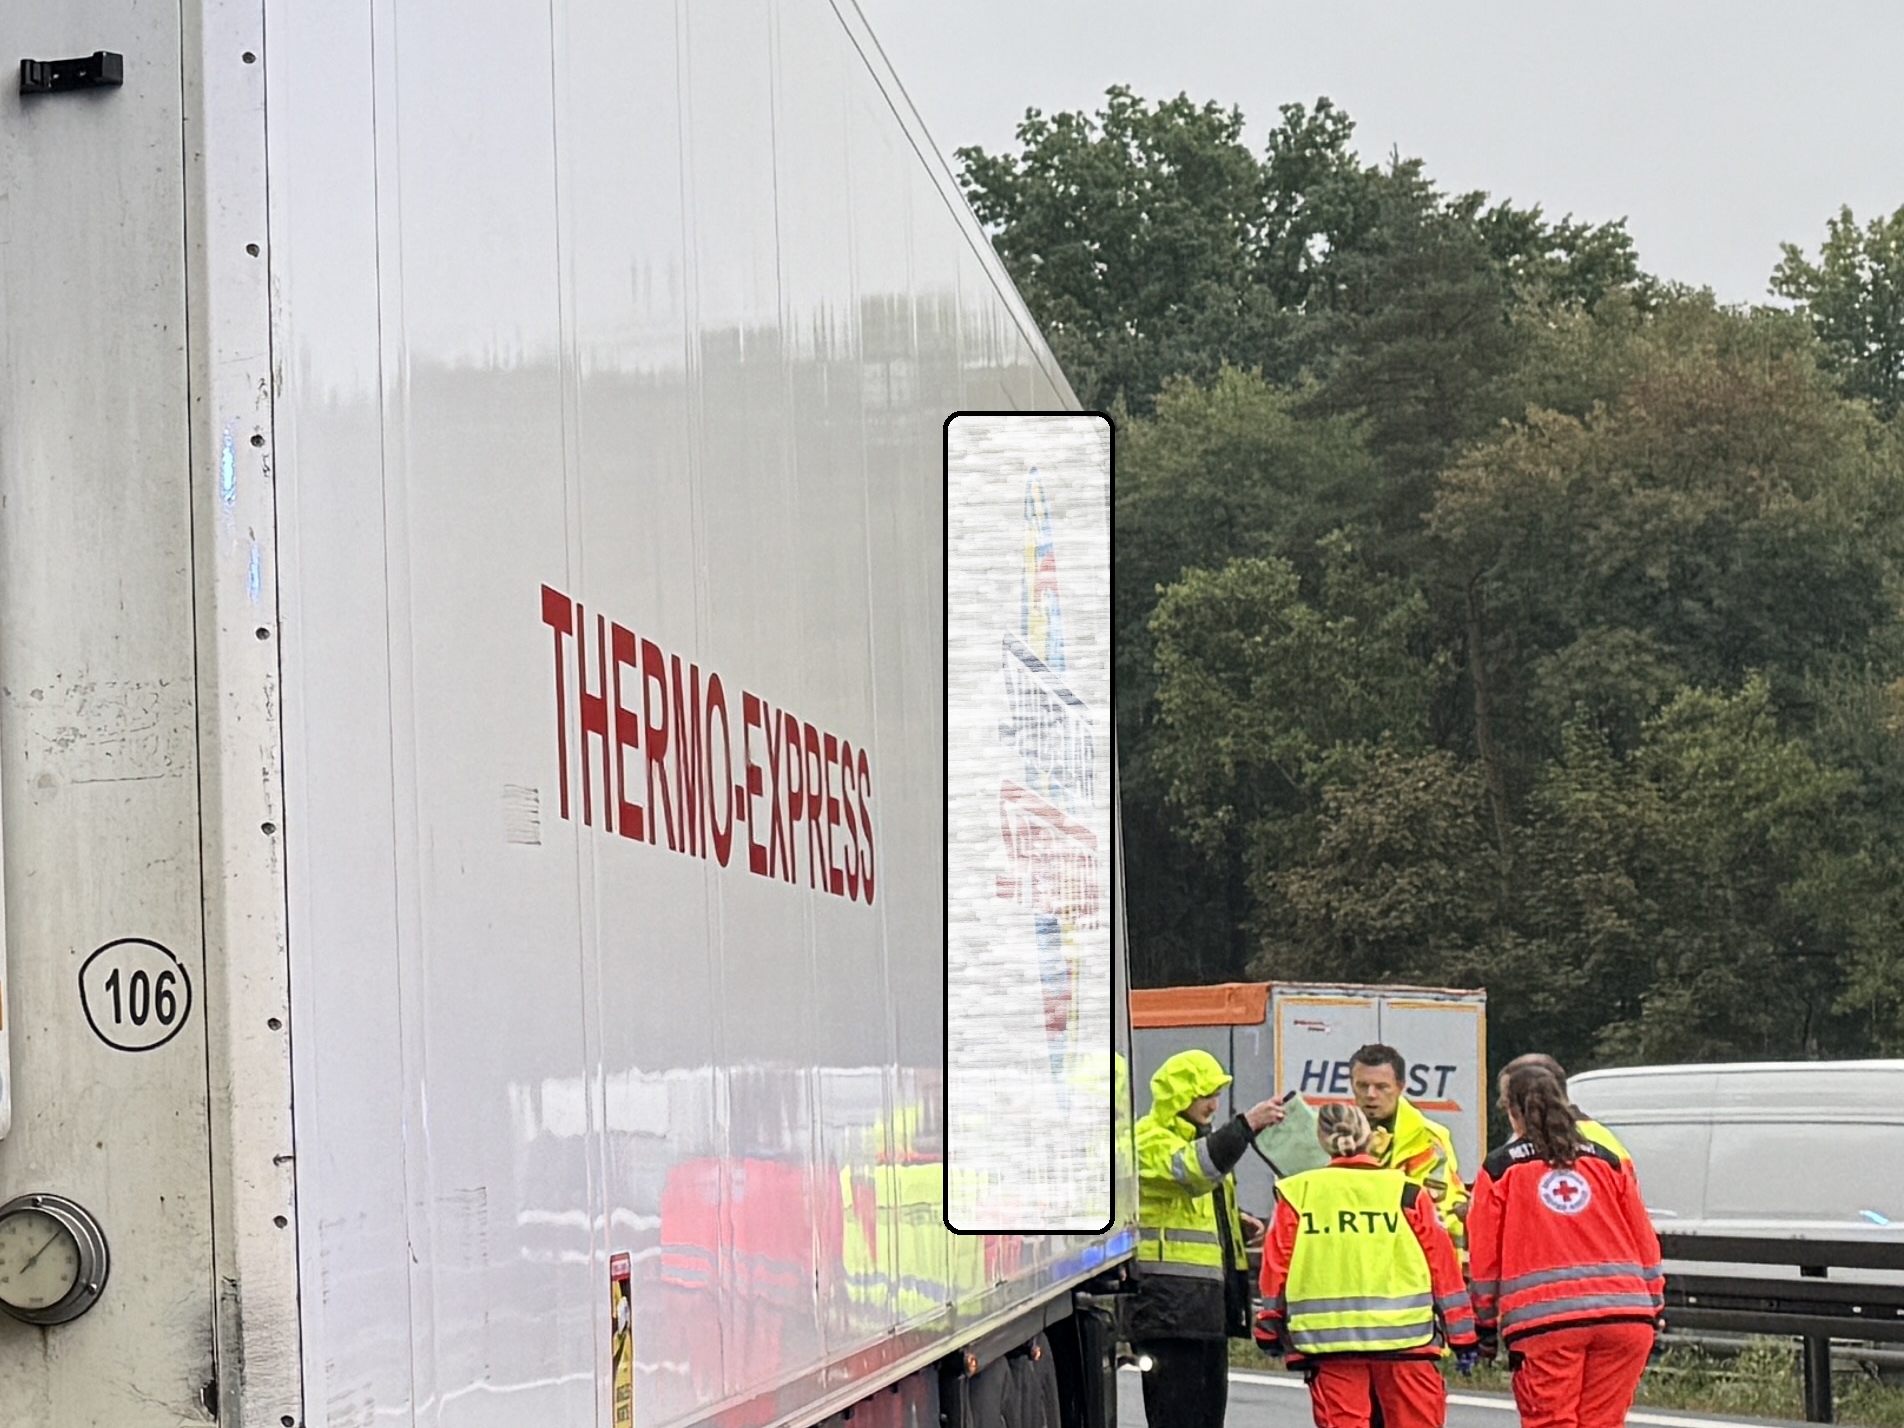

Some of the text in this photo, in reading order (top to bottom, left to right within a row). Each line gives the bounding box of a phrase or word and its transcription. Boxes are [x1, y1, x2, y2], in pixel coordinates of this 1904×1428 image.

[541, 583, 875, 906] THERMO-EXPRESS
[105, 968, 177, 1026] 106
[1299, 1059, 1458, 1098] HEST
